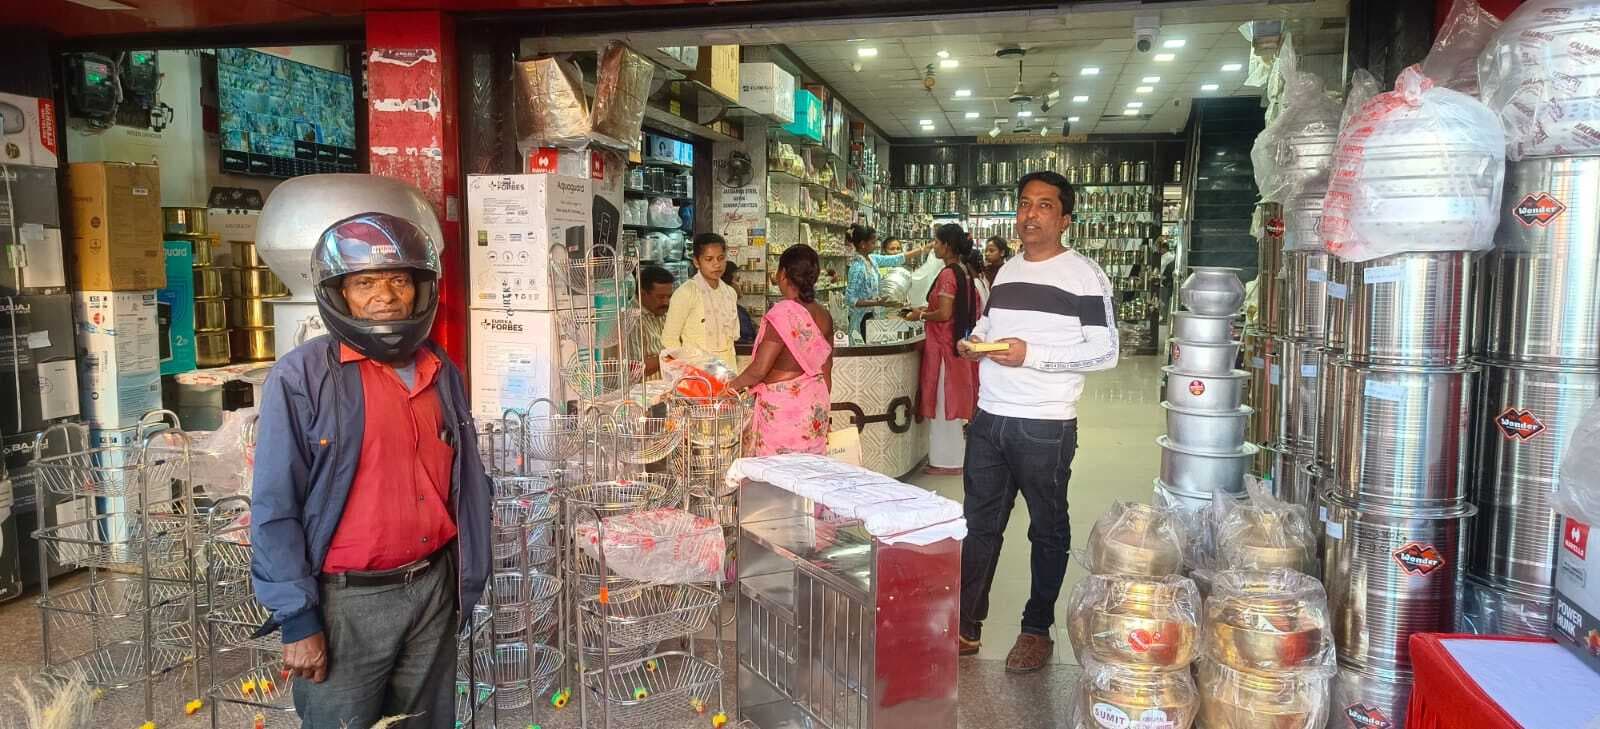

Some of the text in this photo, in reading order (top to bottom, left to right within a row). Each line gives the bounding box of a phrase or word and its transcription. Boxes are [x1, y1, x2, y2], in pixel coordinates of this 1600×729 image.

[1518, 206, 1556, 215] Wonder
[491, 324, 523, 332] FORBES
[1501, 418, 1538, 430] Wonder
[1565, 540, 1584, 557] HAVELLS
[1400, 553, 1438, 566] Wonder
[1557, 599, 1583, 629] POWER
[1556, 611, 1576, 638] HUNK
[1094, 707, 1125, 725] SUMIT
[1348, 708, 1388, 727] Wonder
